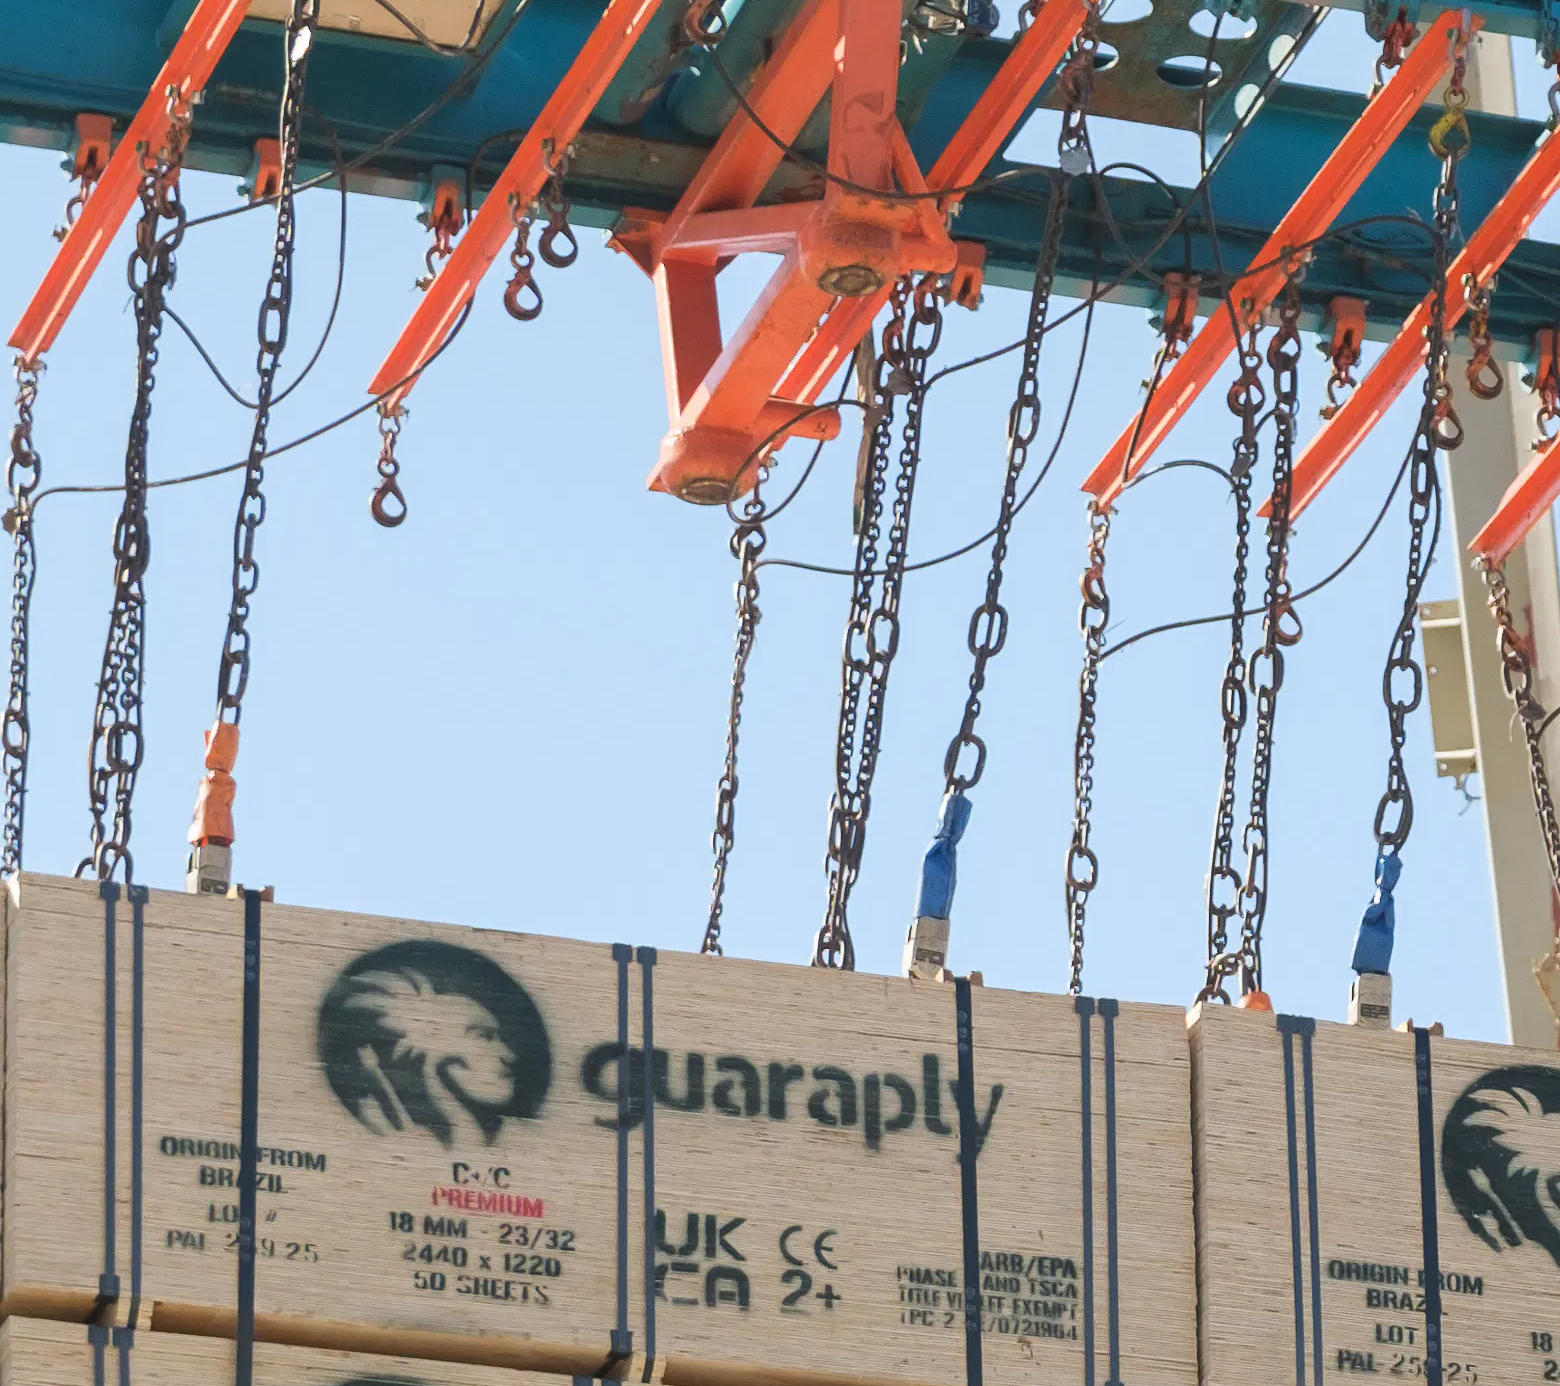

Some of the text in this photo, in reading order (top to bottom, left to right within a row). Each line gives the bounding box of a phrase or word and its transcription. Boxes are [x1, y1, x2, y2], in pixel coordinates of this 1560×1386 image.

[581, 1042, 1004, 1163] guaraply
[431, 1187, 544, 1219] PREMIUM
[389, 1212, 577, 1252] 18 MM 23/32
[654, 1210, 747, 1261] UK
[402, 1242, 468, 1269] 2440
[504, 1252, 561, 1278] 1220
[1328, 1259, 1409, 1286] ORIGIN
[414, 1272, 550, 1304] 50 SHEETS
[653, 1262, 841, 1313] CA 2+
[1375, 1323, 1419, 1345] LOT
[1531, 1332, 1552, 1352] 18
